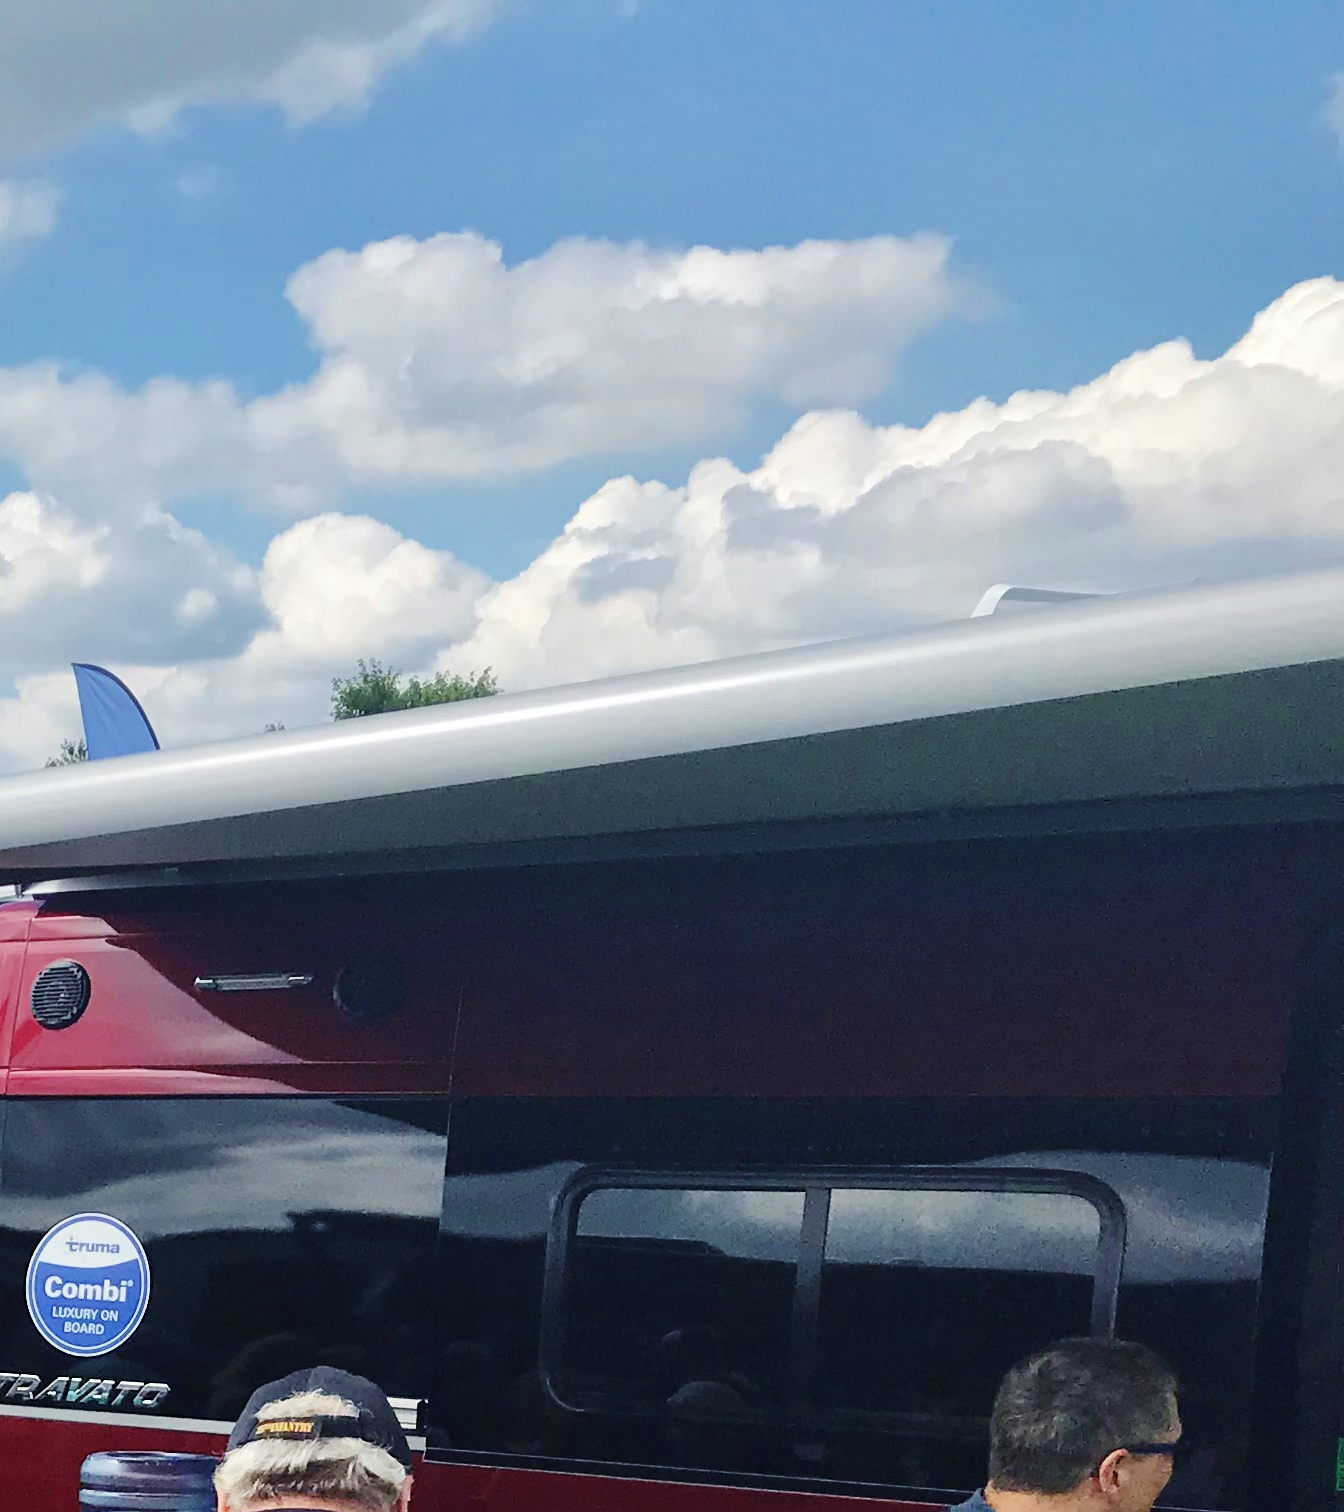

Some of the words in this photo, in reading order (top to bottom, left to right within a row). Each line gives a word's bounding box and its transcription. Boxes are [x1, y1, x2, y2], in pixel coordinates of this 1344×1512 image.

[65, 1236, 120, 1255] truma
[52, 1305, 99, 1321] LUXURY
[100, 1310, 119, 1322] ON
[64, 1321, 105, 1335] BOARD
